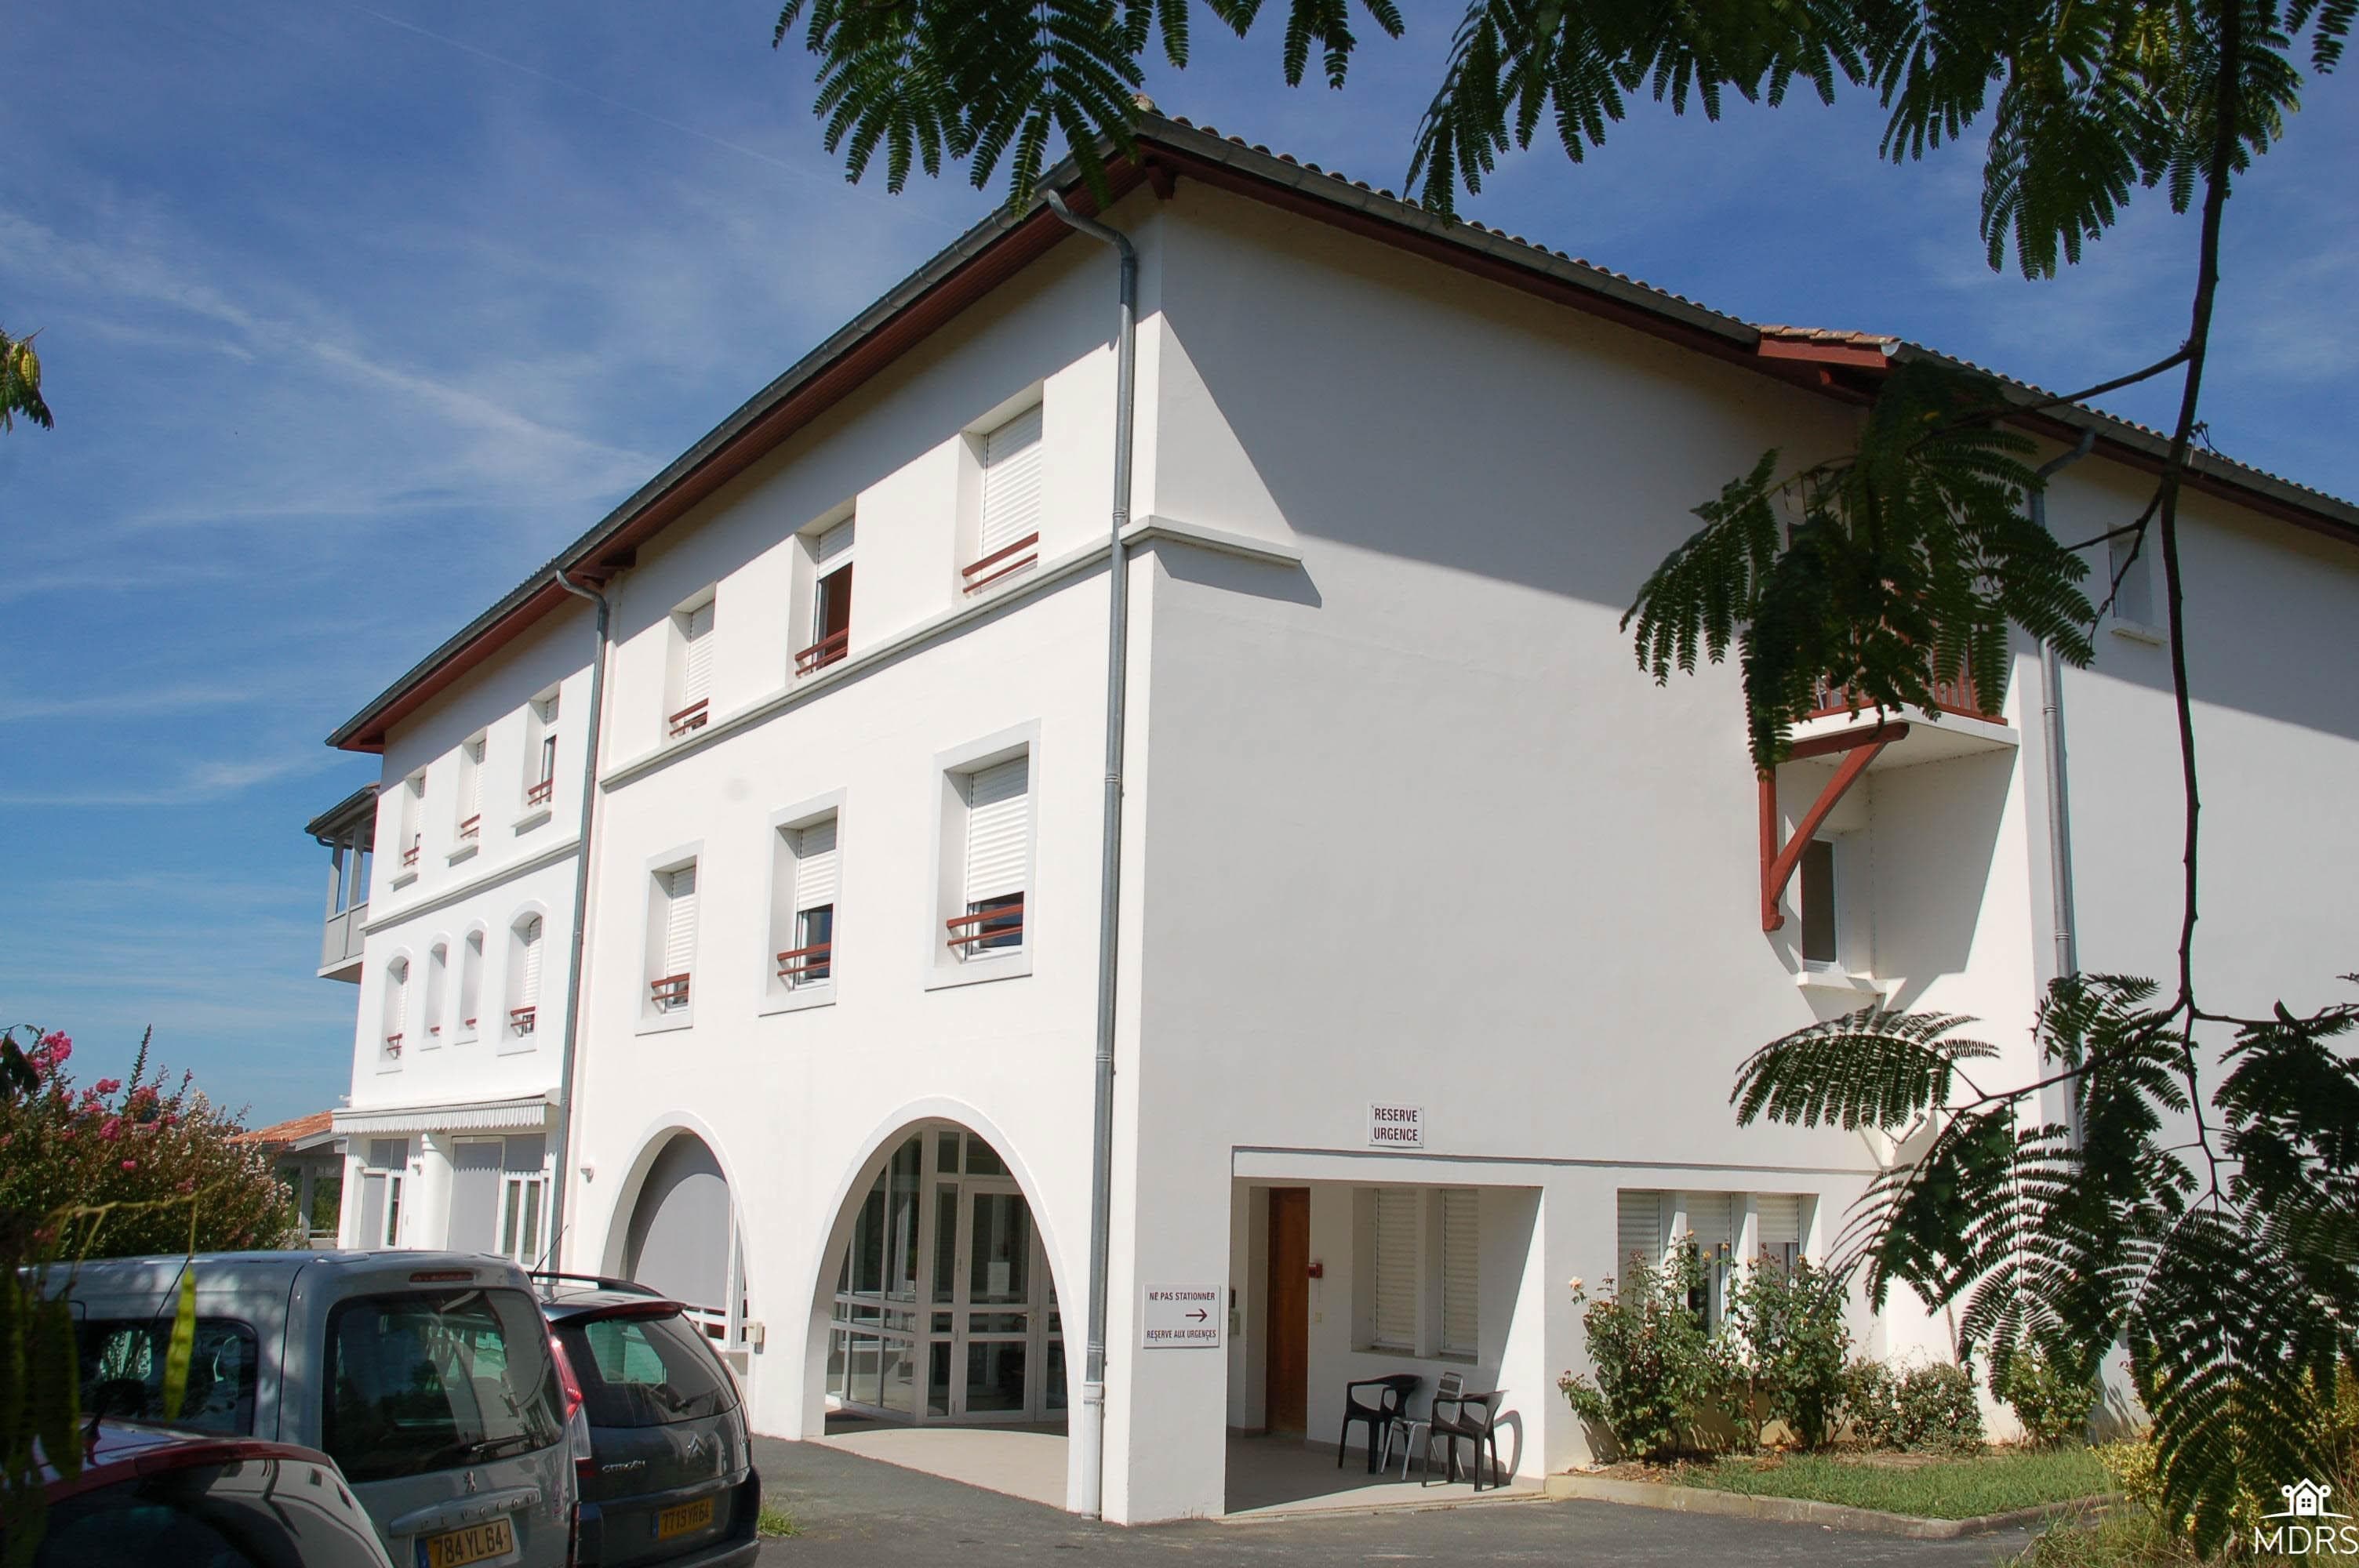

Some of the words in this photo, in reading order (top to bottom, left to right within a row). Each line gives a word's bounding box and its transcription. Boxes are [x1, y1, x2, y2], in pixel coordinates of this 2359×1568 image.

[1374, 1108, 1417, 1122] RESERVE
[1374, 1127, 1418, 1141] URGENCE
[1149, 1292, 1159, 1301] NE
[1160, 1292, 1173, 1301] PAS
[1175, 1292, 1216, 1301] STATIONNER
[1147, 1330, 1172, 1339] RESERVE
[1173, 1330, 1186, 1339] AUX
[1187, 1330, 1216, 1338] URGENCES
